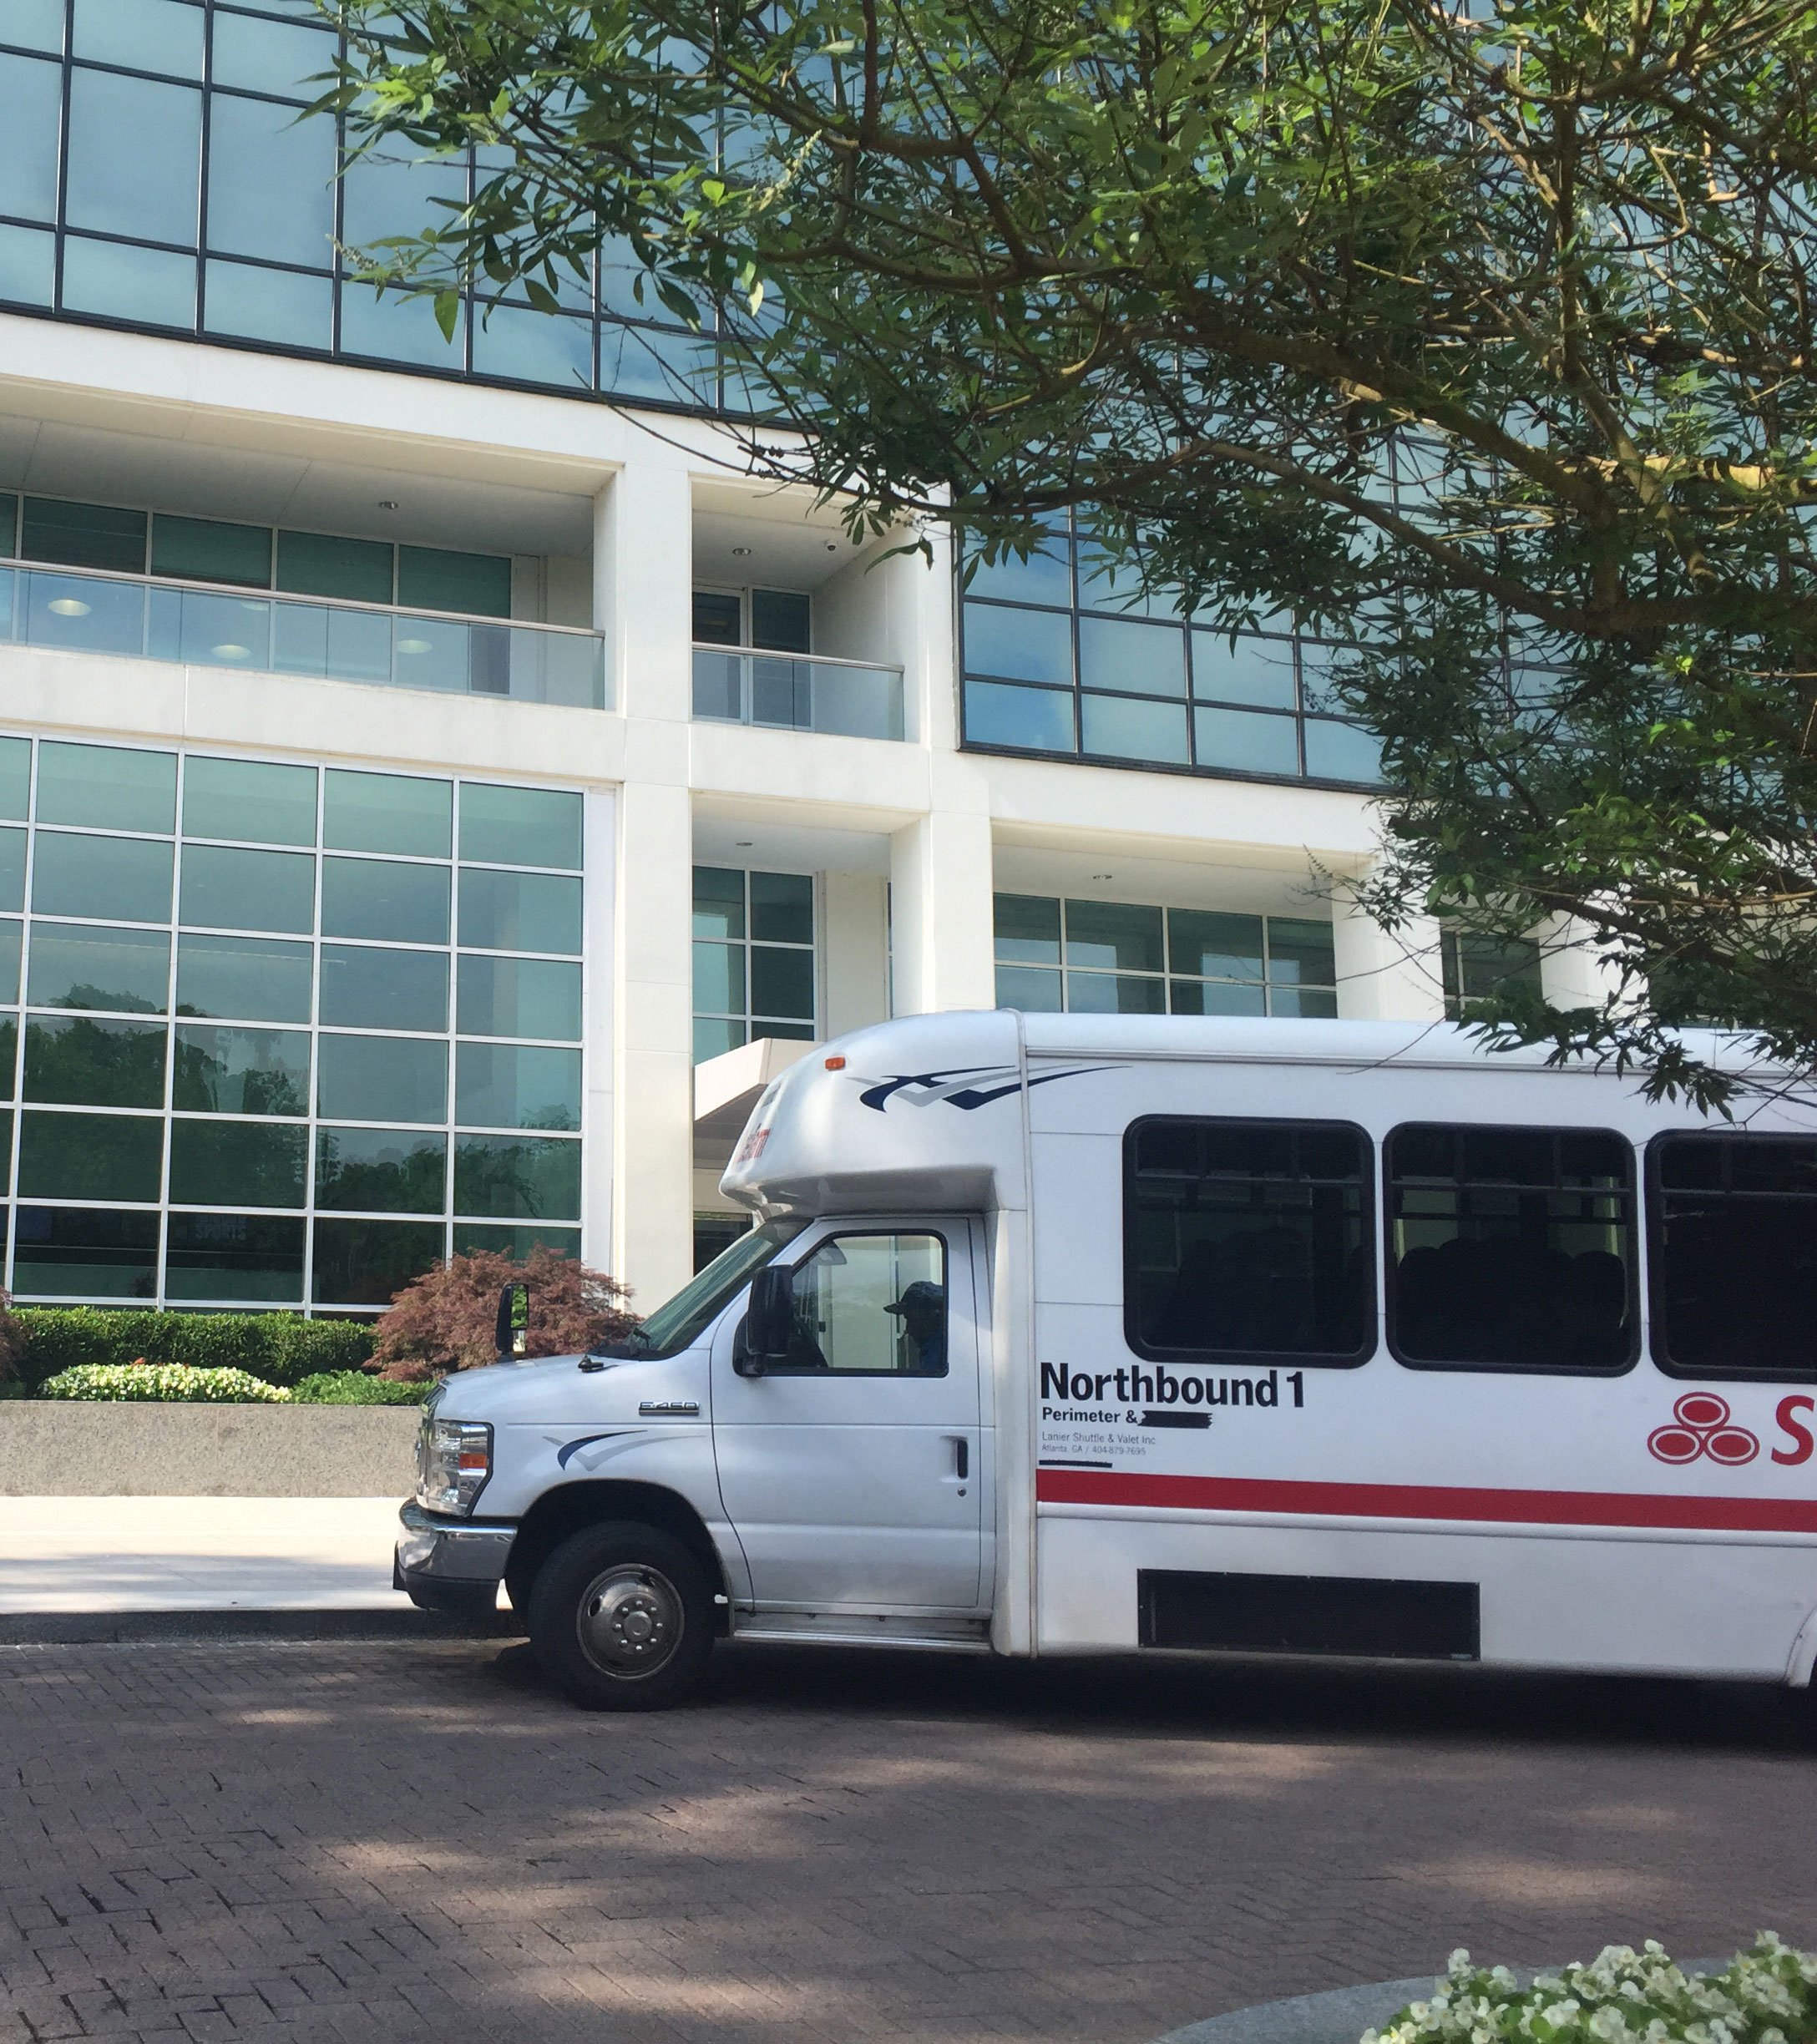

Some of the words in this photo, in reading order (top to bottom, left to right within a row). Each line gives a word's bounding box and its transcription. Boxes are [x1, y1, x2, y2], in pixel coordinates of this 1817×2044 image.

[1040, 1362, 1278, 1407] Northbound
[1286, 1371, 1304, 1408] 1
[1042, 1407, 1121, 1424] Perimeter
[1126, 1409, 1138, 1424] &
[1042, 1431, 1070, 1441] Lanier
[1073, 1432, 1105, 1443] Shuttle
[1107, 1433, 1115, 1443] &
[1117, 1434, 1140, 1444] Valet
[1141, 1435, 1157, 1444] Inc
[1071, 1444, 1083, 1453] GA
